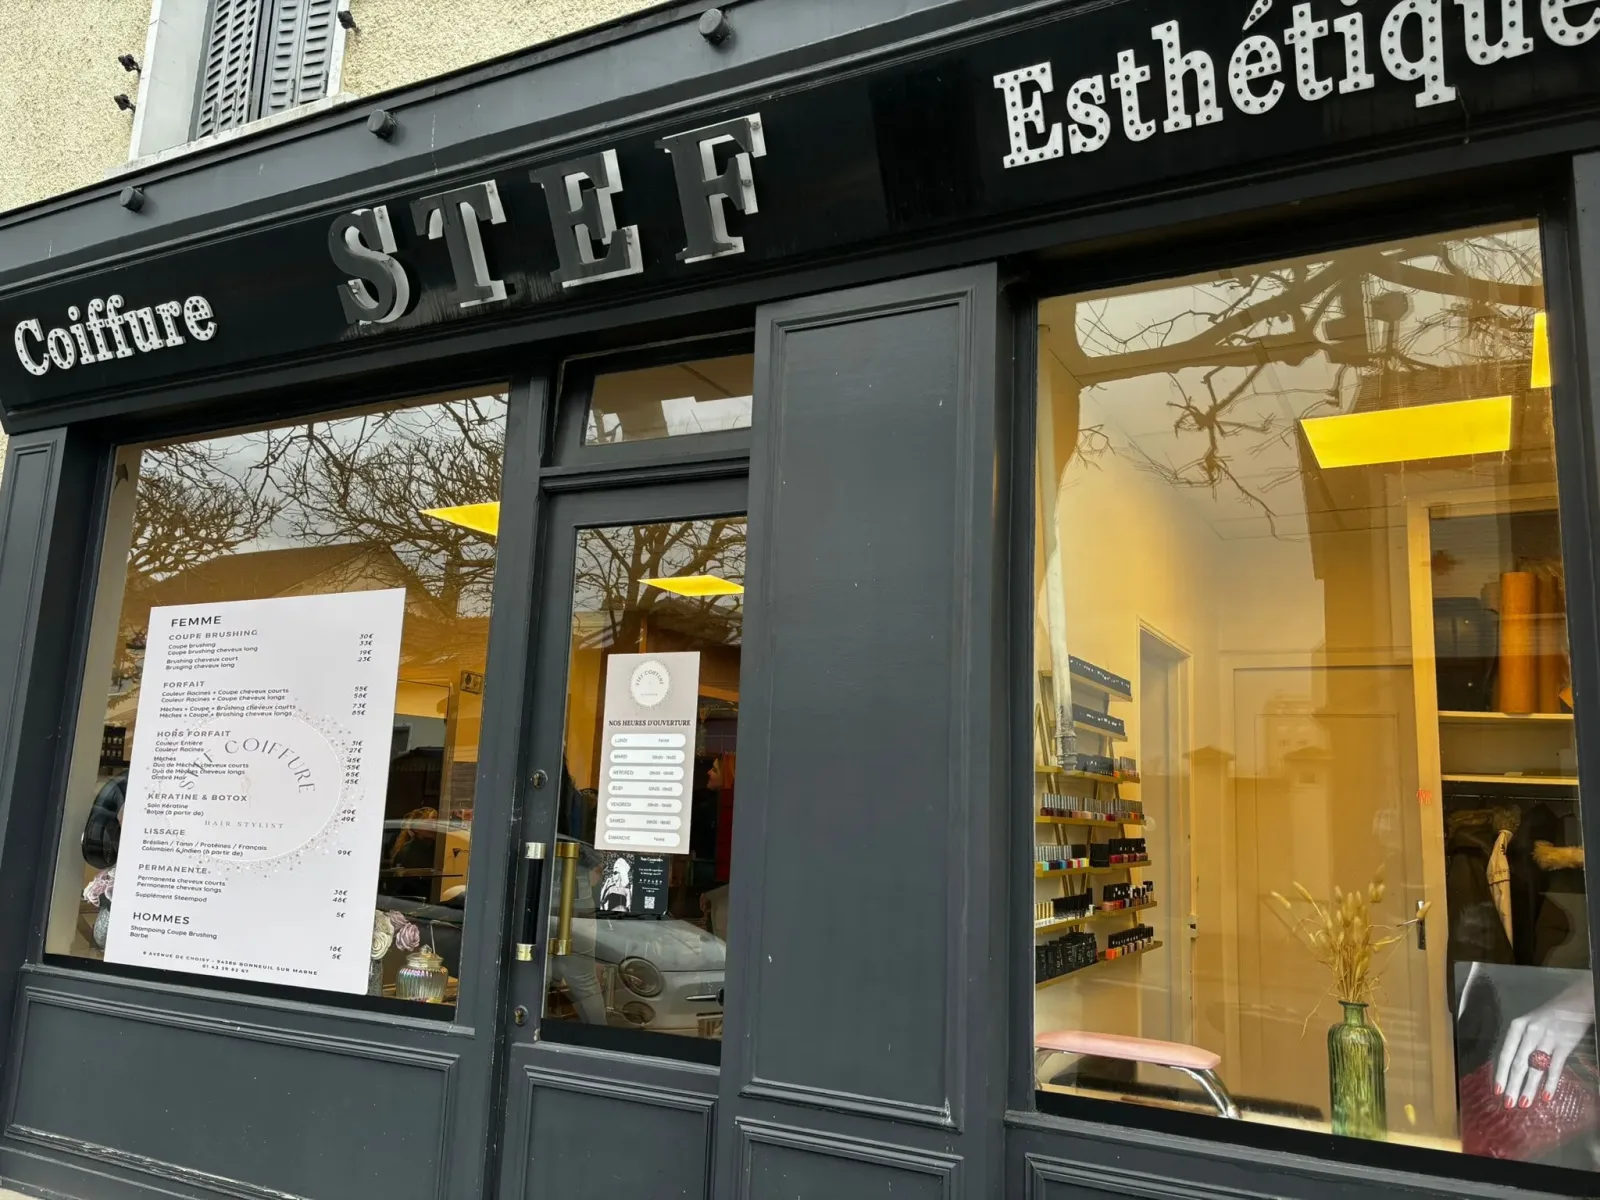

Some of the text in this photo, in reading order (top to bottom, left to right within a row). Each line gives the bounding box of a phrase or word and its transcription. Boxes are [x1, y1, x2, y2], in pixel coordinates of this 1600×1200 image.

[327, 112, 767, 326] STEF
[14, 294, 218, 376] Coiffure
[171, 616, 222, 628] FEMME
[205, 630, 258, 638] BRUSHING
[224, 737, 316, 794] COIFFURE
[238, 821, 284, 829] STYLIST
[144, 828, 185, 836] LISSAGE
[138, 864, 207, 874] PERMANENTE
[133, 912, 190, 925] HOMMES
[131, 925, 165, 934] Shampoing
[189, 931, 217, 940] Brushing
[239, 962, 273, 970] BONNEUIL
